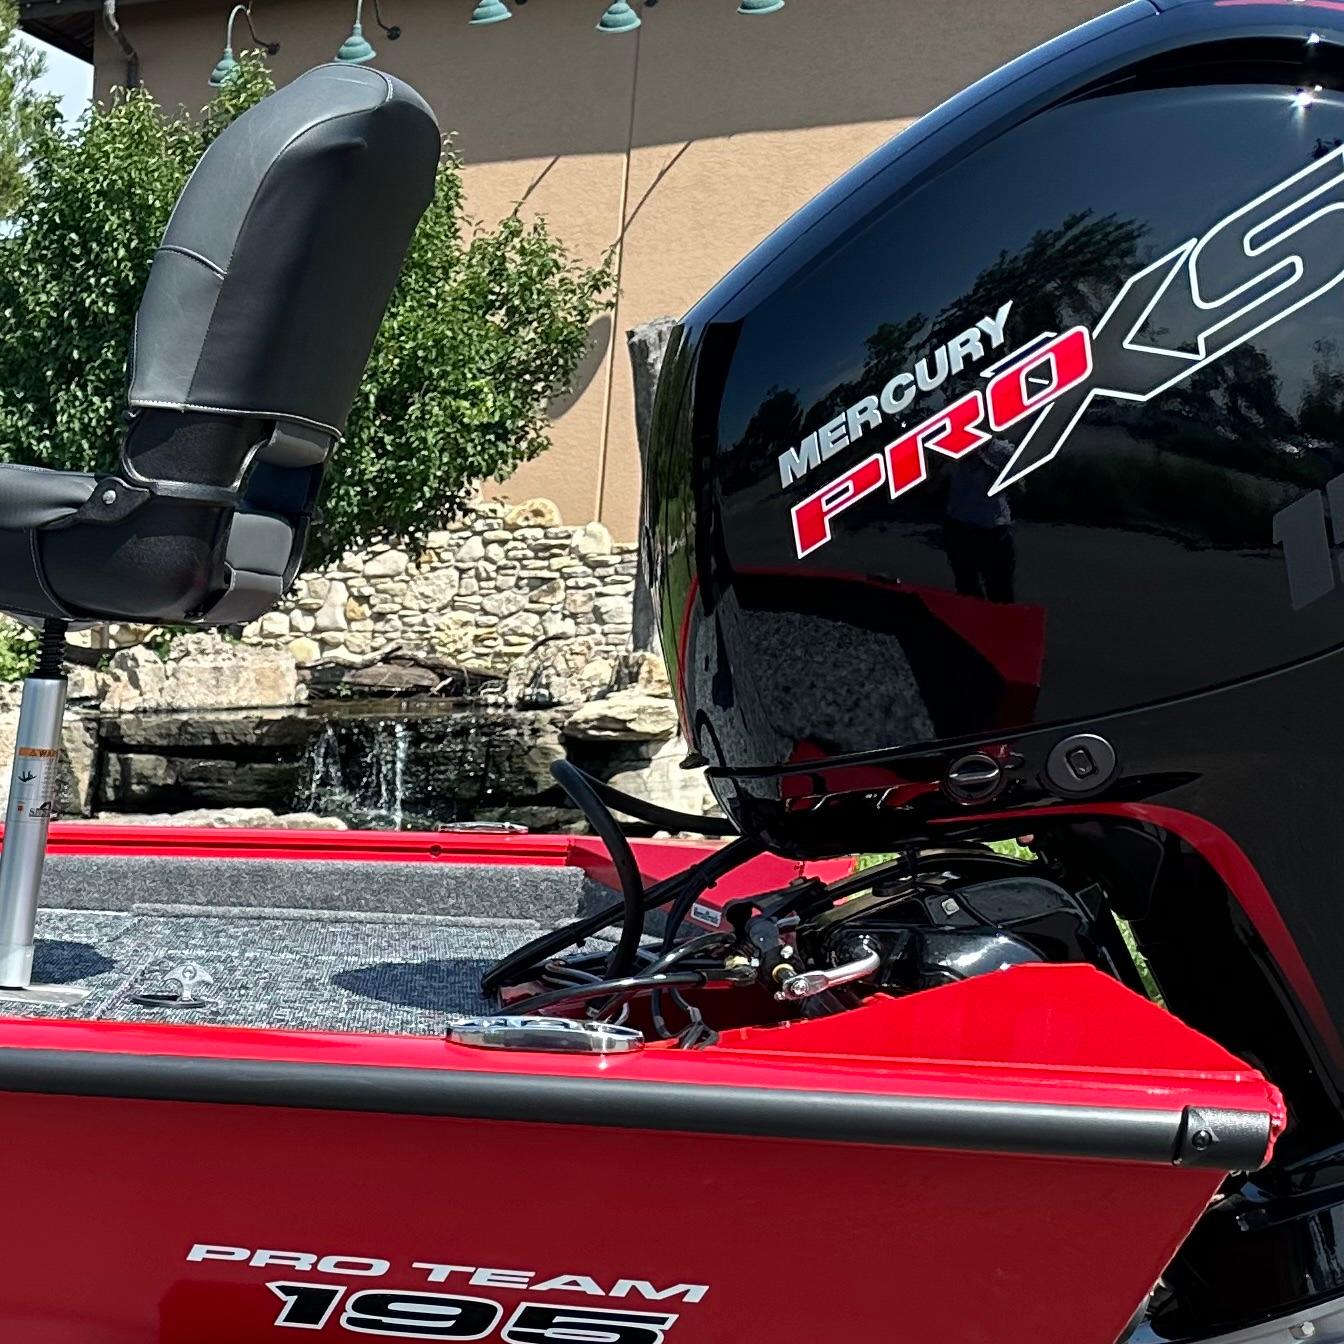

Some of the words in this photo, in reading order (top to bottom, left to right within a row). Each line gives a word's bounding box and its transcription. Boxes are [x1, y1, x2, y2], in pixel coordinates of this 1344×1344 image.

[778, 299, 1014, 489] MERCURY
[790, 324, 1094, 560] PRO
[186, 1243, 392, 1278] PRO
[411, 1261, 710, 1304] TEAM
